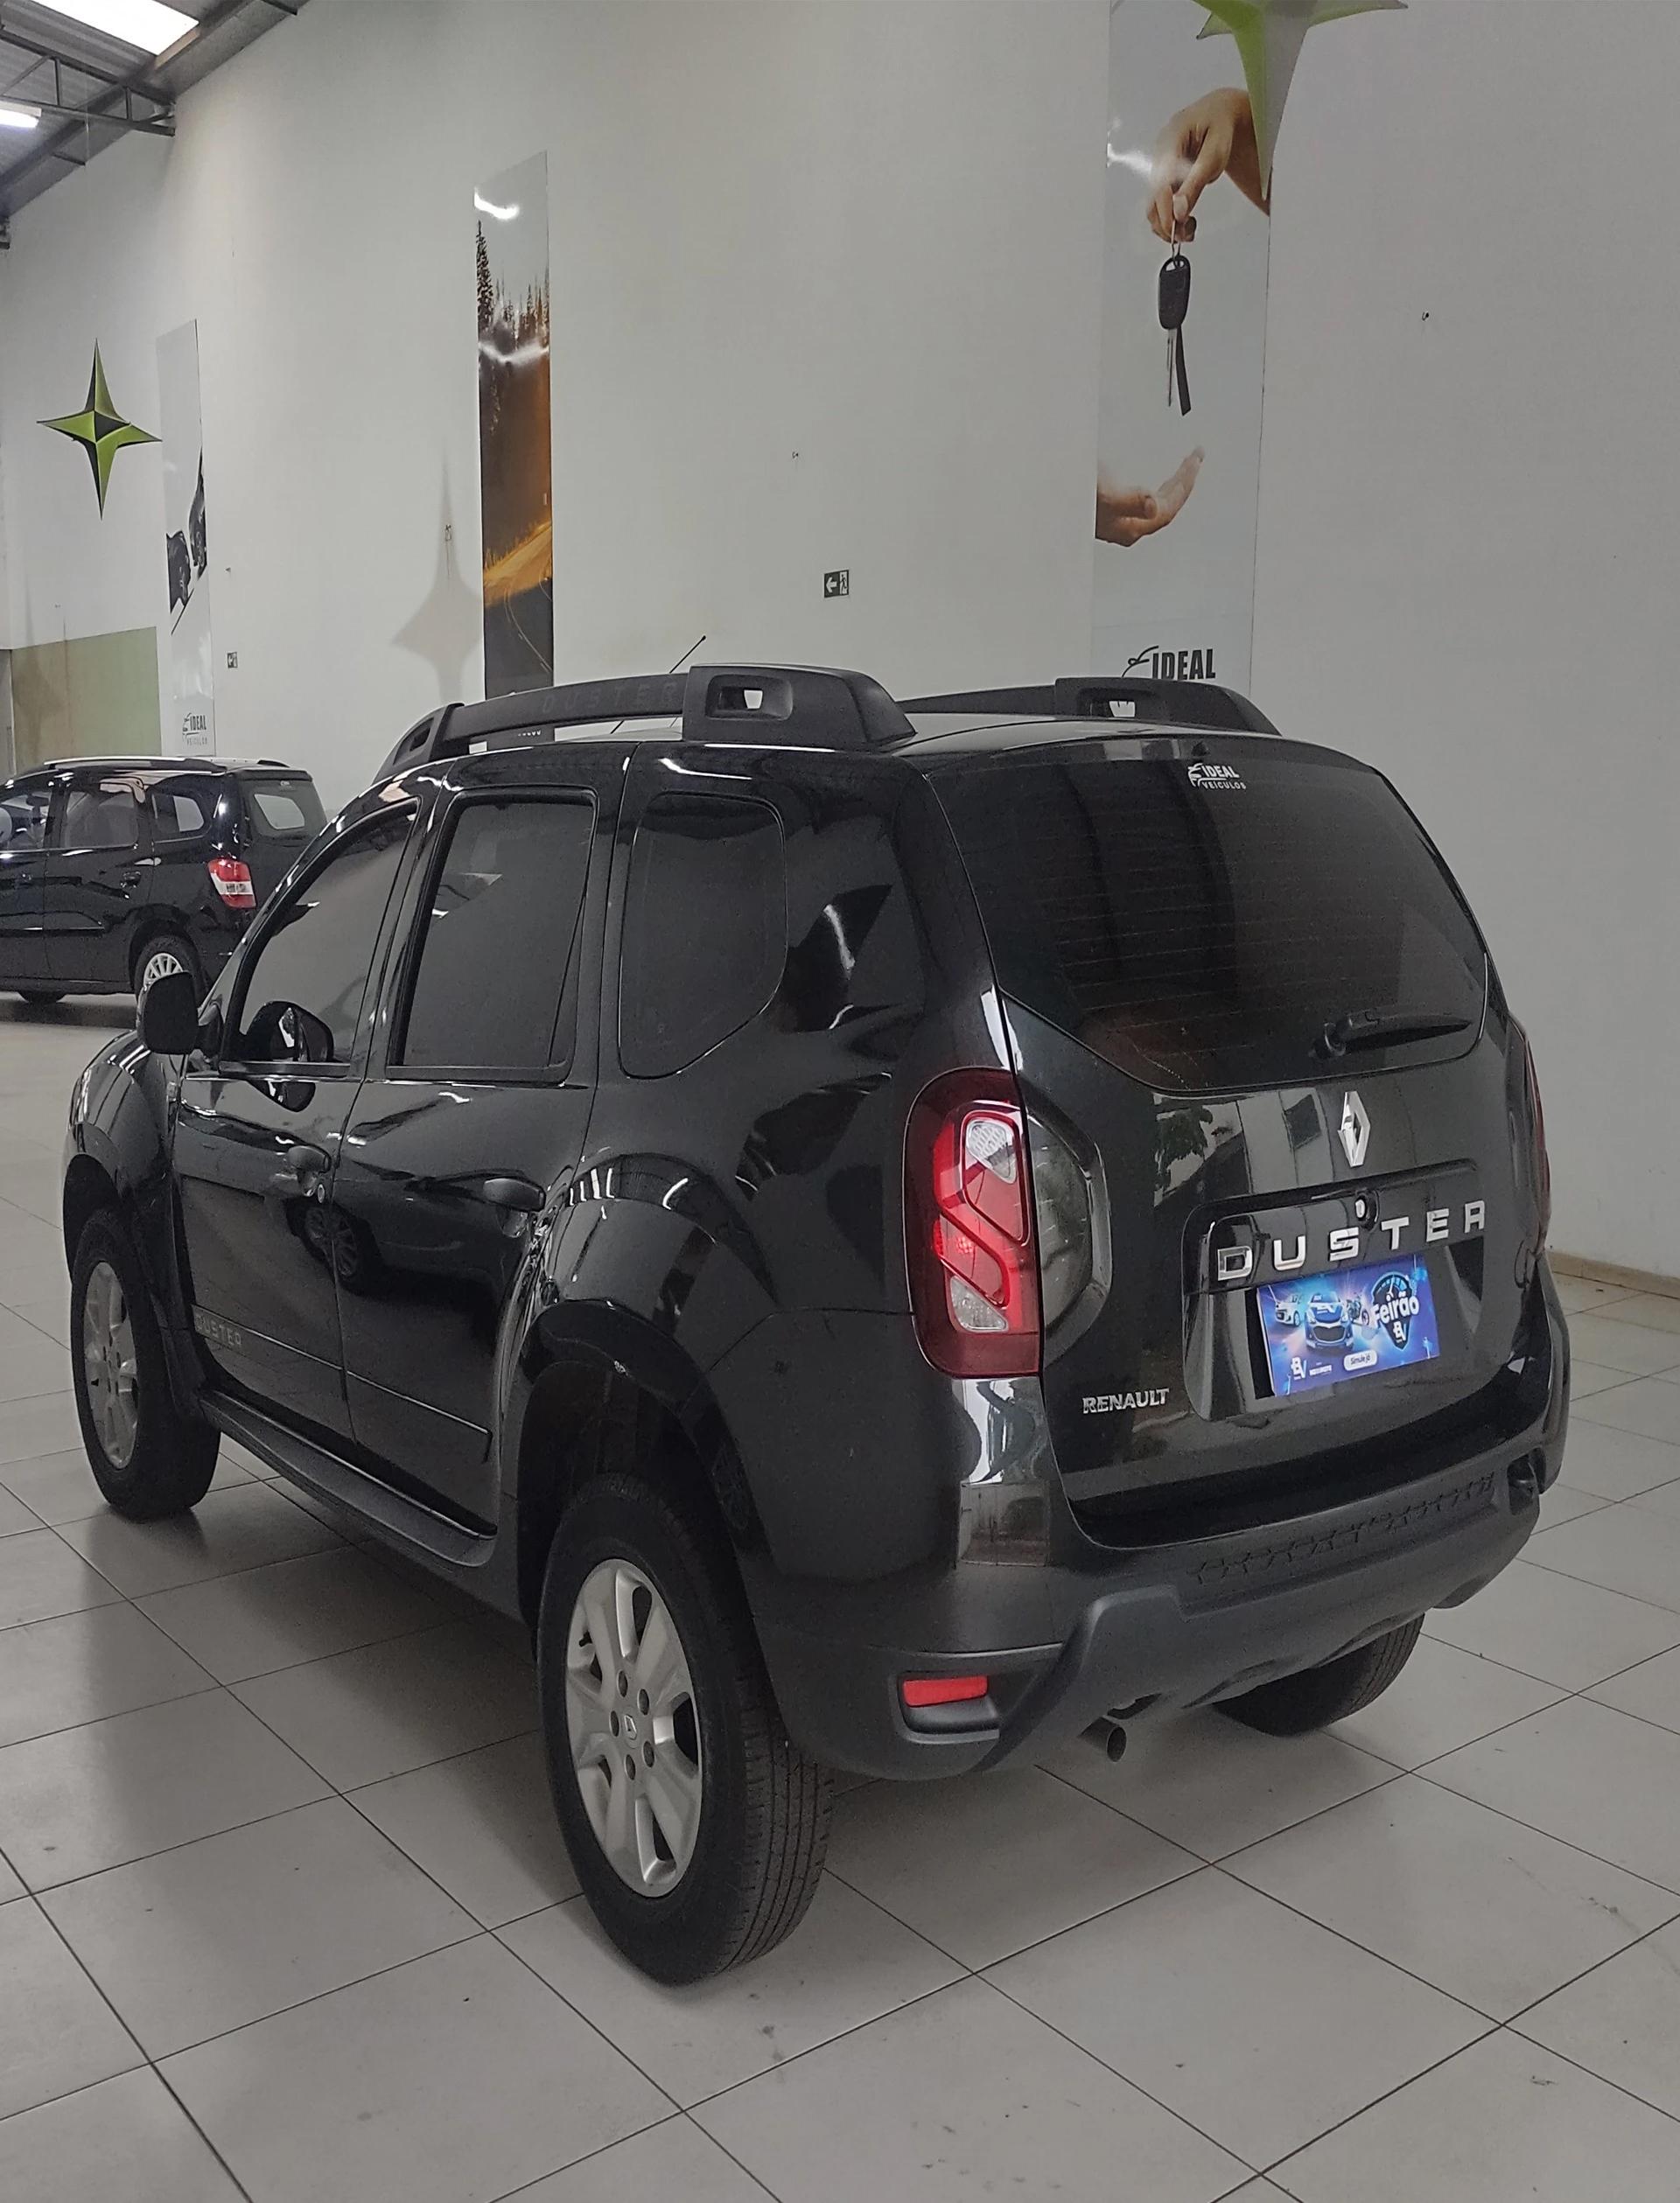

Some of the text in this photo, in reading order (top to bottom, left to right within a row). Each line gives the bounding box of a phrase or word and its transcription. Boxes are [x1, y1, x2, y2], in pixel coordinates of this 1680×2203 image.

[1152, 648, 1216, 680] IDEAL
[189, 715, 206, 731] IDEAL
[1201, 765, 1240, 779] IDEAL
[1217, 1199, 1486, 1281] DUSTER
[1371, 1290, 1419, 1327] Feirão
[1082, 1388, 1169, 1414] RENAULT
